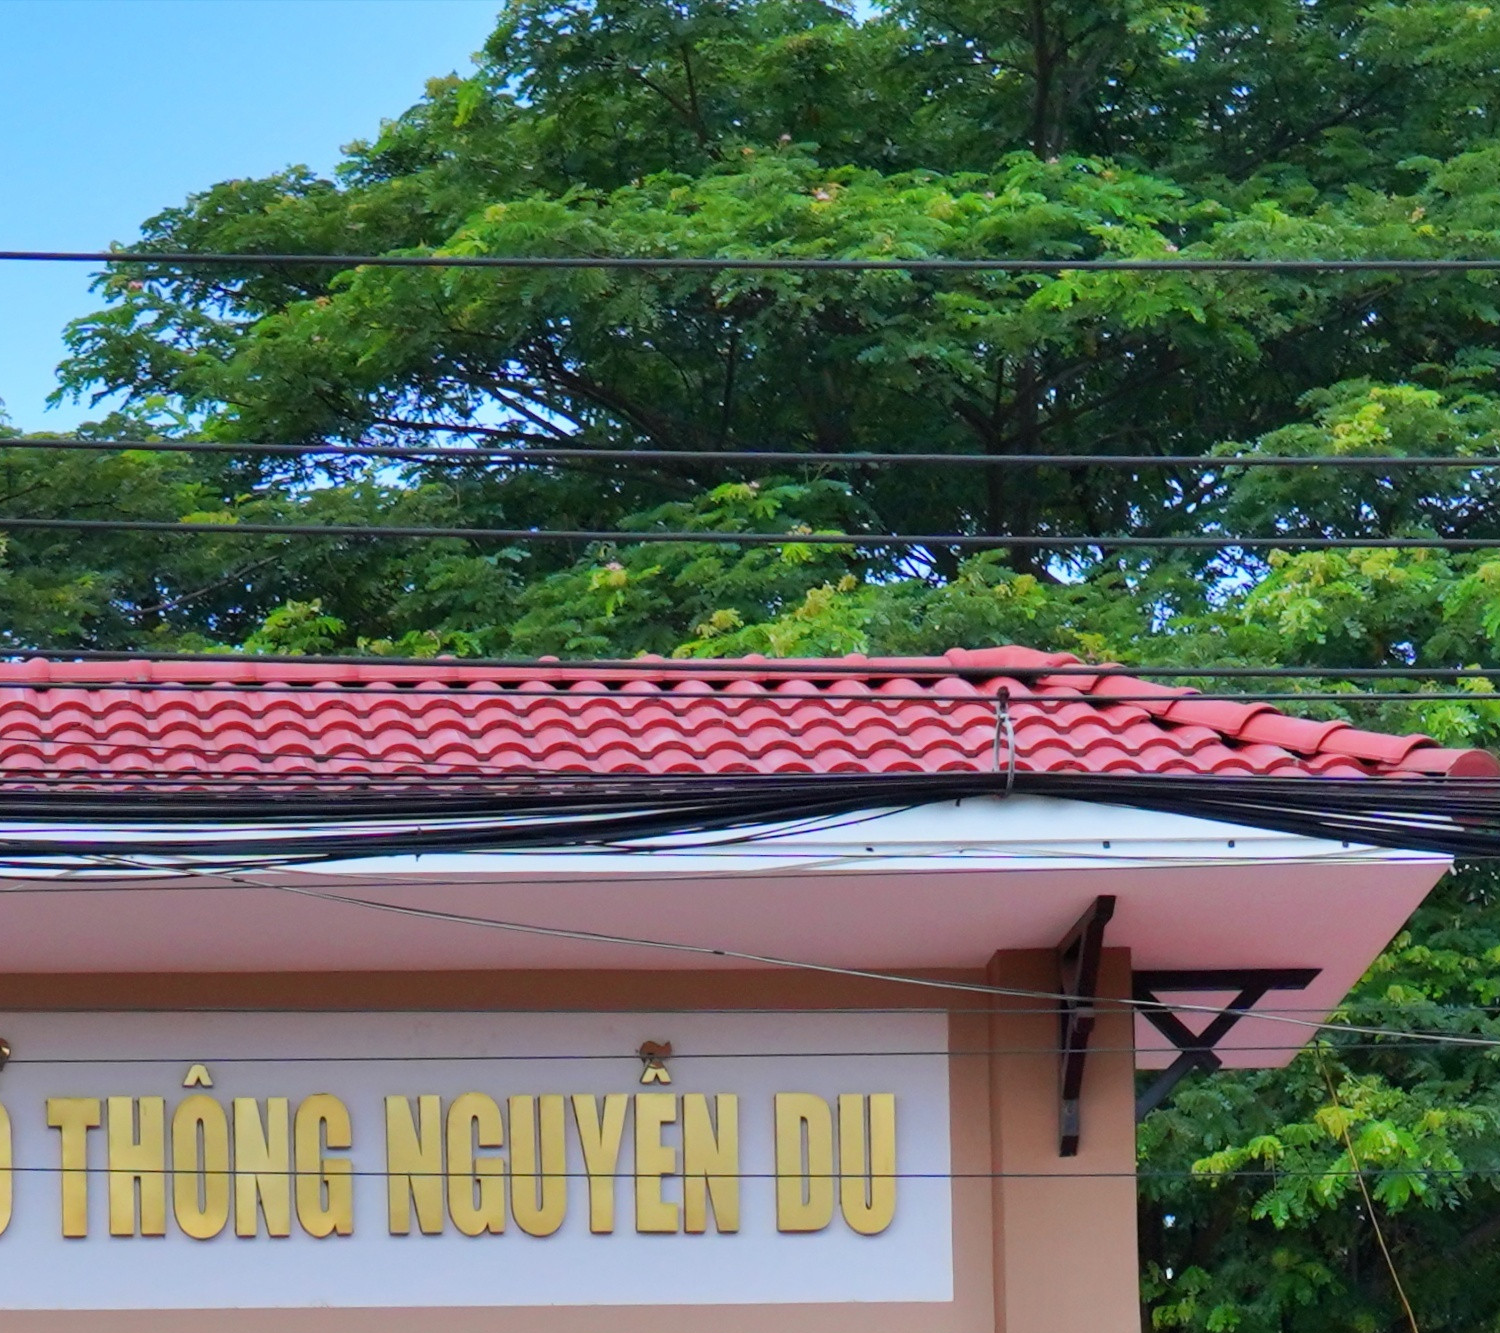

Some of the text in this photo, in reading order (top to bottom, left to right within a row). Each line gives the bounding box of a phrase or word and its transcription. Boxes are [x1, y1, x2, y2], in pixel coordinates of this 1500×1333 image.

[45, 1061, 355, 1241] THÔNG
[383, 1038, 742, 1239] NGUYỄN
[773, 1091, 899, 1238] DU
